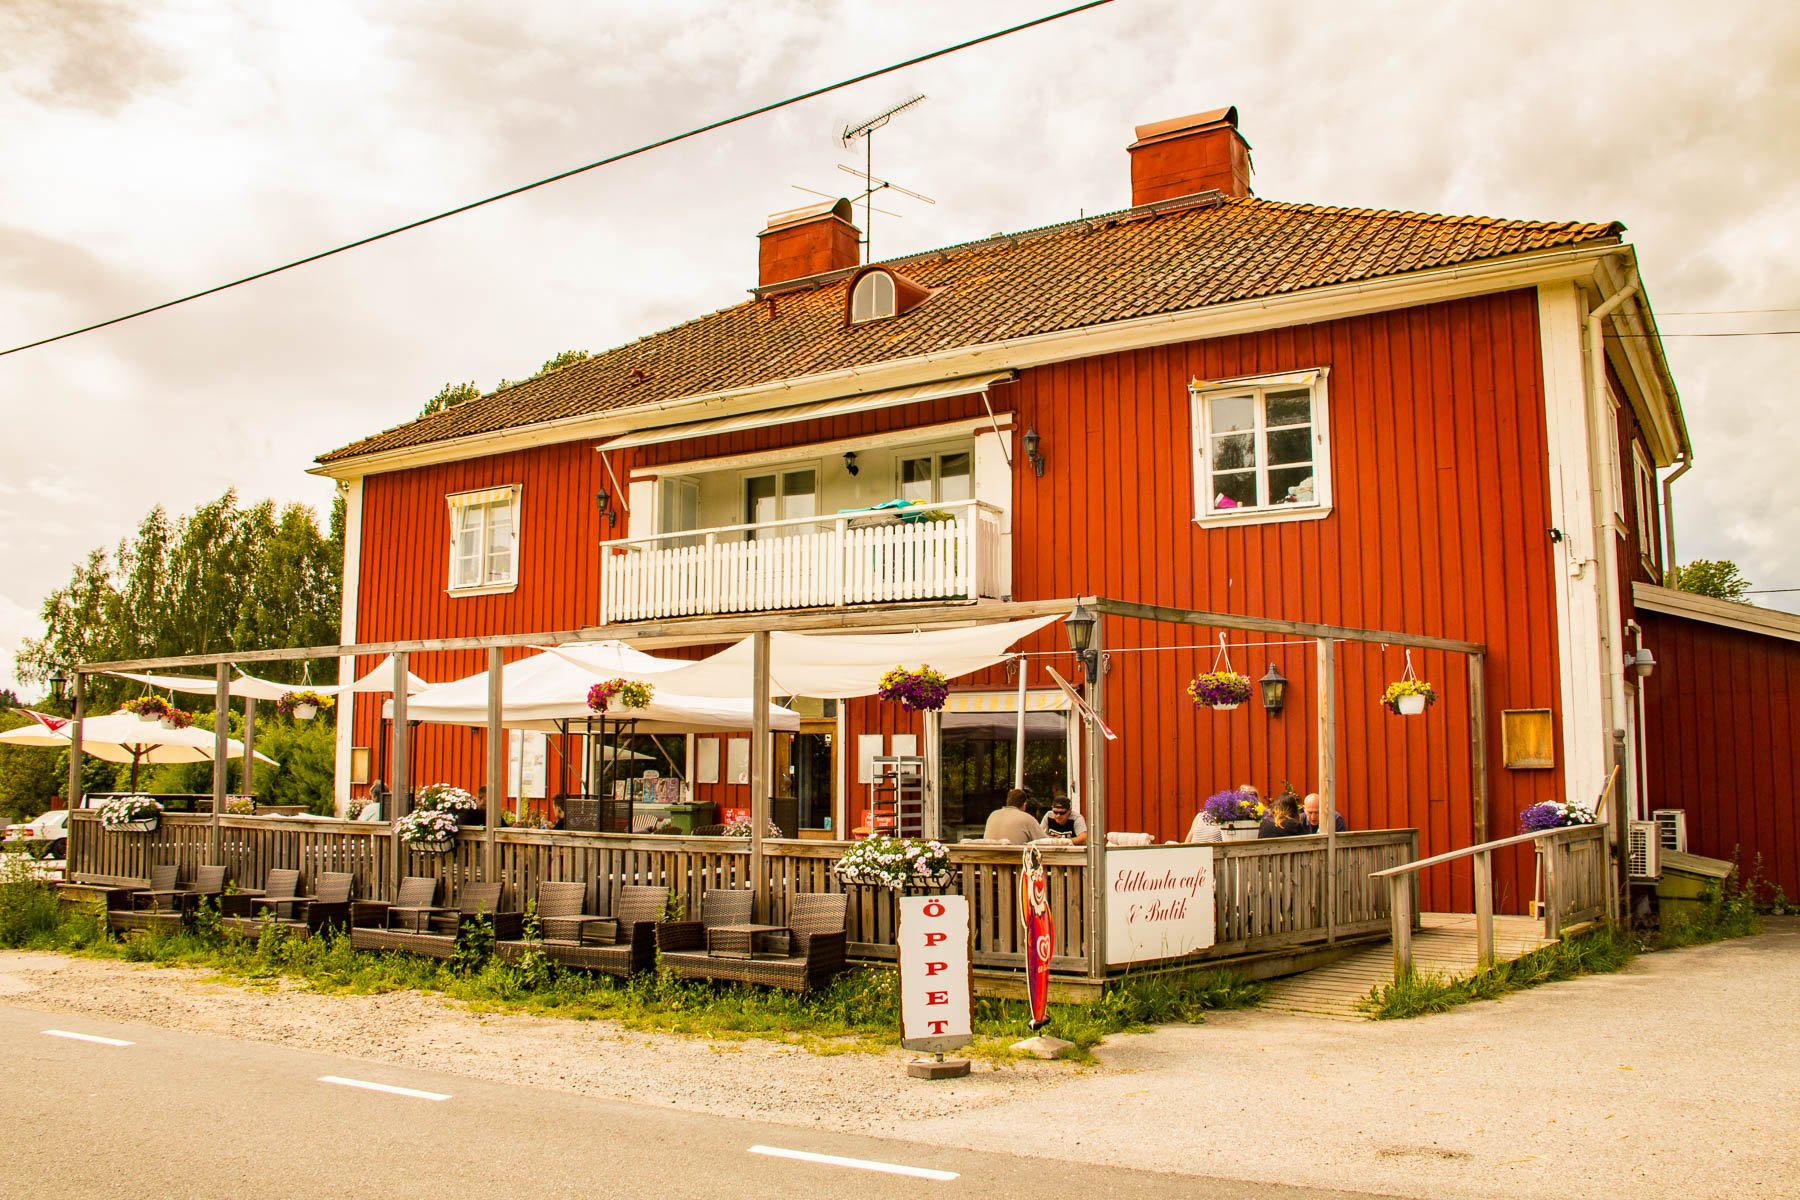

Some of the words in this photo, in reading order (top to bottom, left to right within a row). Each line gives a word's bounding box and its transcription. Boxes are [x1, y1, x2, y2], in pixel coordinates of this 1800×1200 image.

[1179, 866, 1207, 897] café
[1145, 898, 1187, 922] Butik
[922, 899, 949, 1035] ÖPPET
